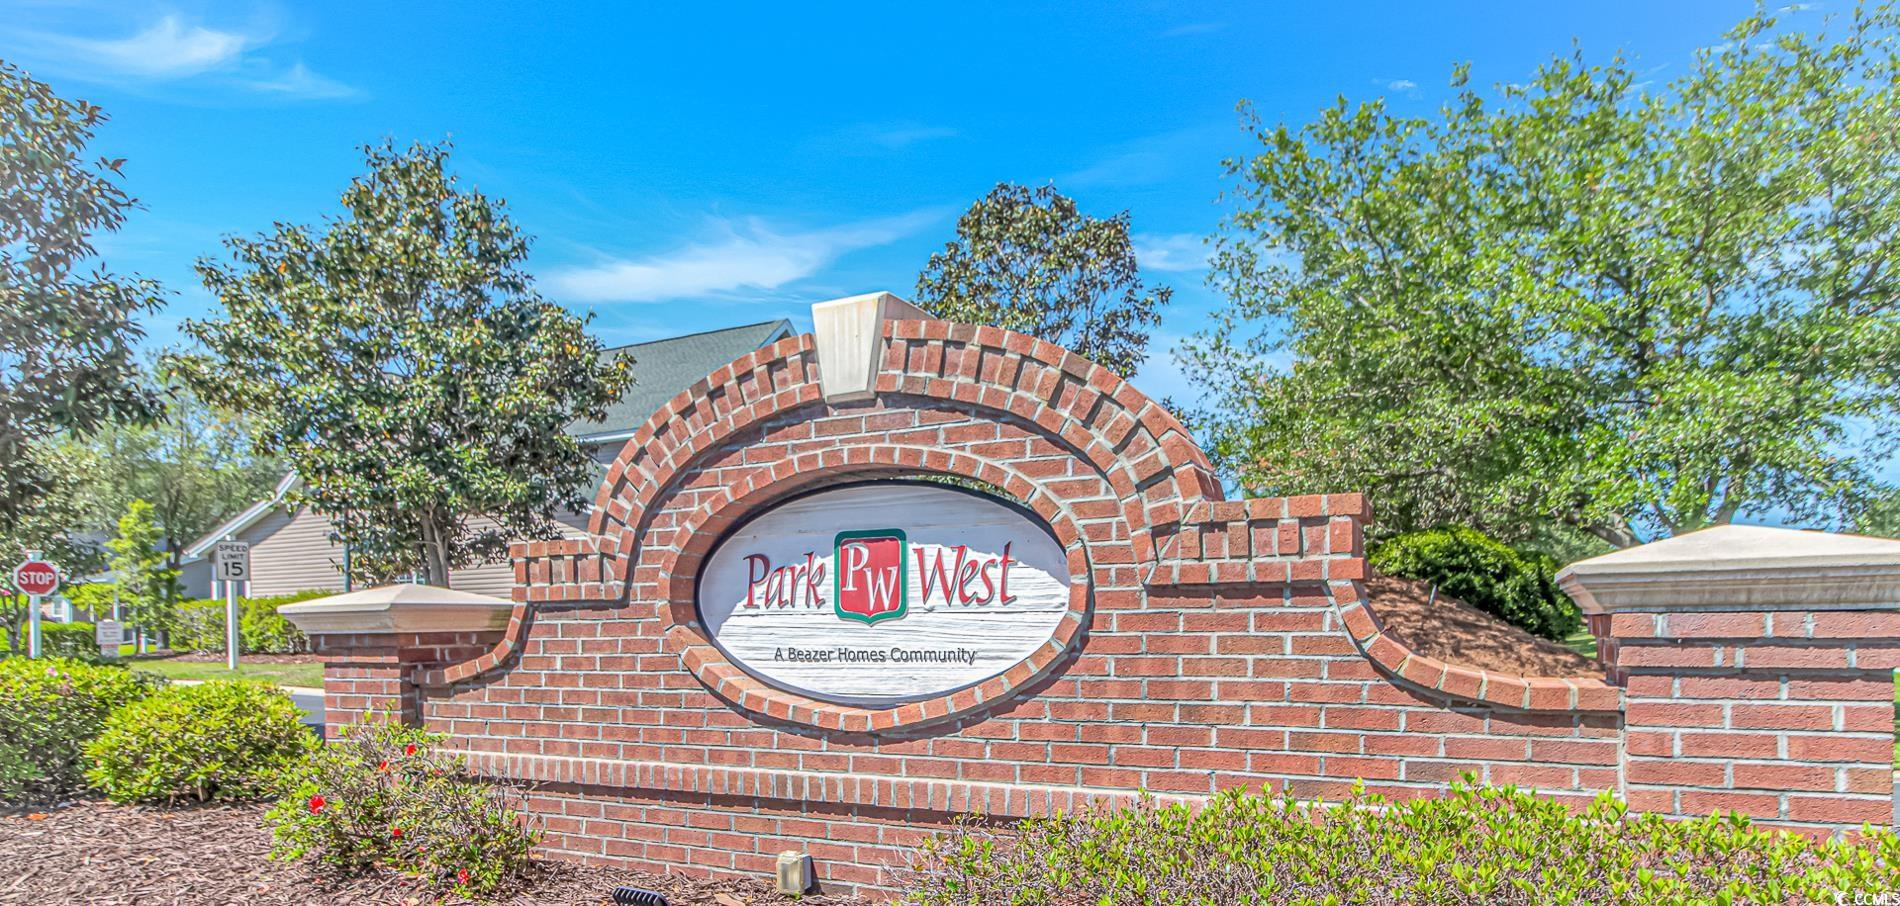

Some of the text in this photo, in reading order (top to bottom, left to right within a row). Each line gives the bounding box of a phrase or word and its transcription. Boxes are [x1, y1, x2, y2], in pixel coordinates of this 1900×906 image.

[219, 544, 248, 552] SPEED
[224, 562, 243, 576] 15
[743, 541, 1017, 611] Park PW West
[20, 571, 54, 584] STOP
[774, 647, 976, 665] A Beazer Homes Community
